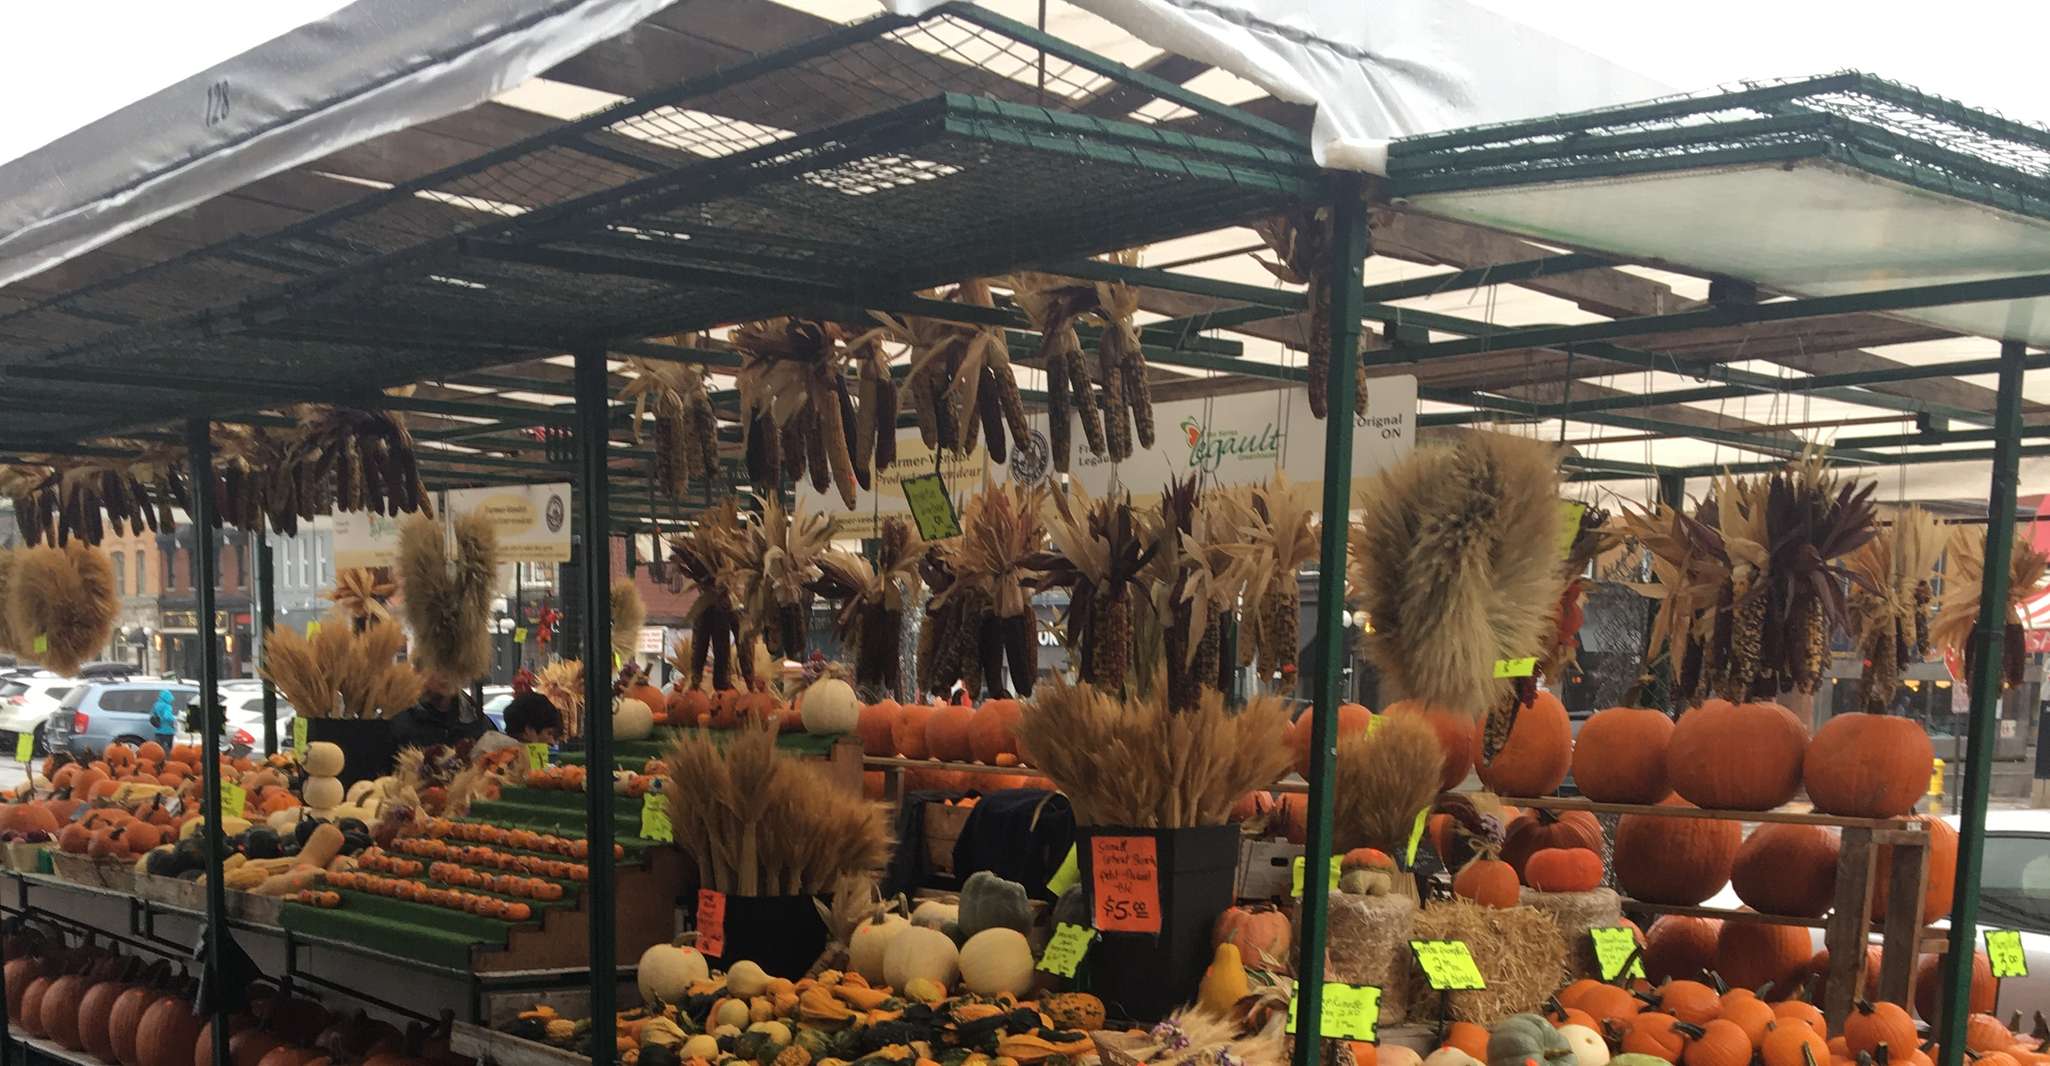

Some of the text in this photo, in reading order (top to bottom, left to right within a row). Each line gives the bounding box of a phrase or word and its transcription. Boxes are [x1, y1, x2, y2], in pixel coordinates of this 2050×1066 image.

[206, 79, 231, 128] 128
[1381, 428, 1401, 440] ON
[1078, 455, 1110, 467] Legau
